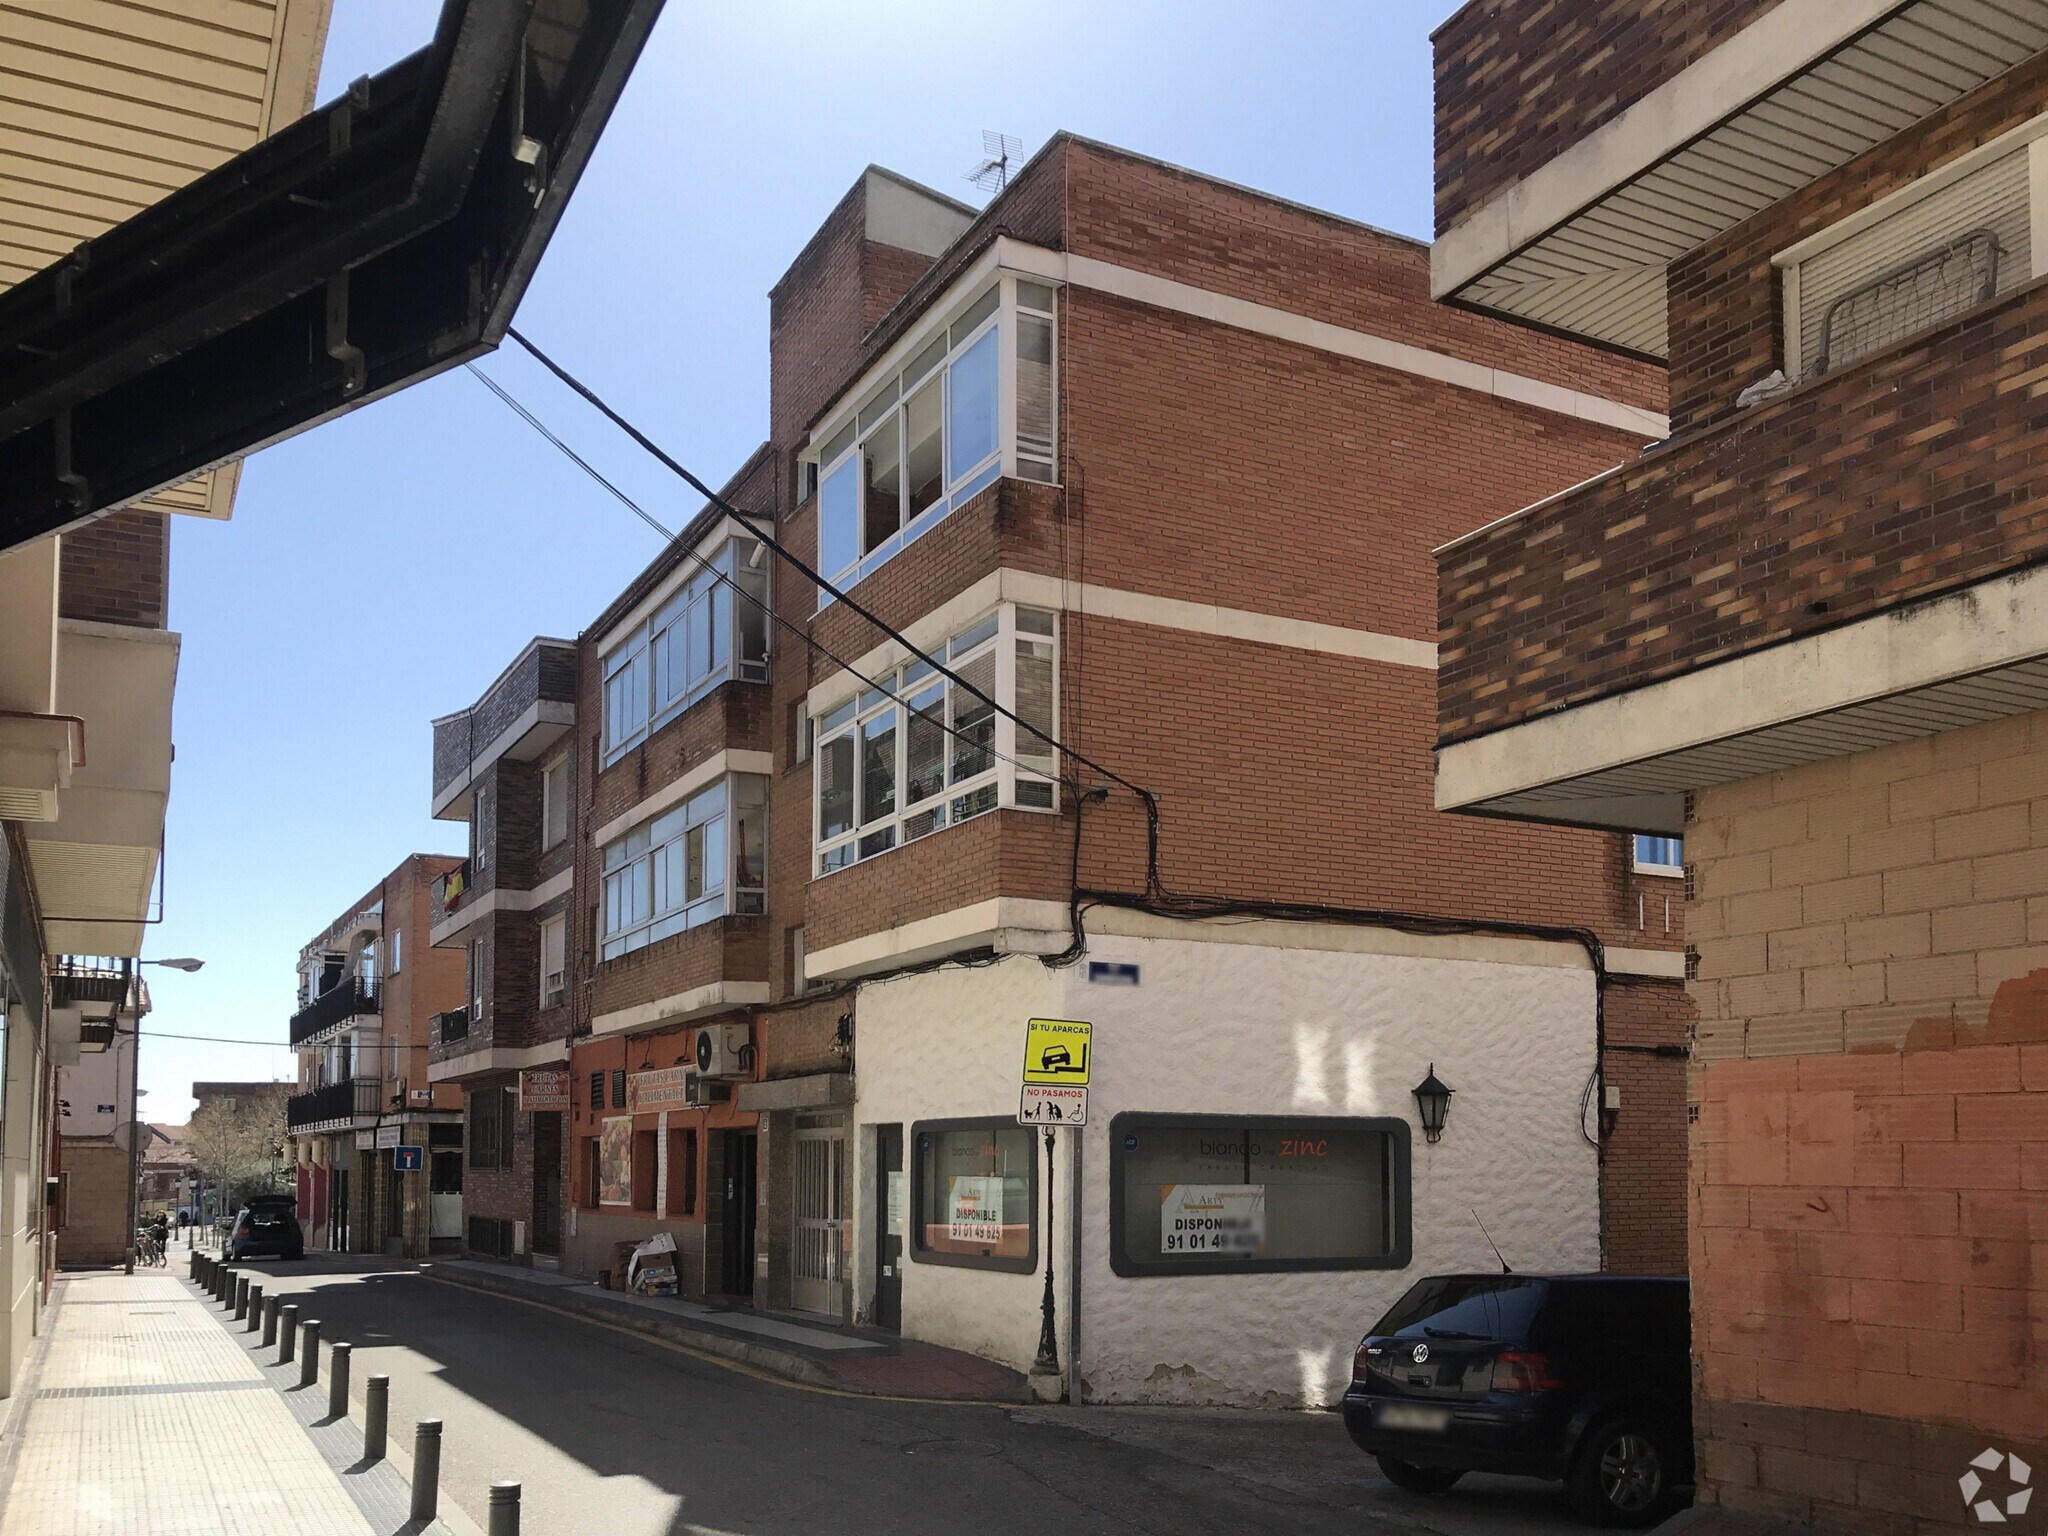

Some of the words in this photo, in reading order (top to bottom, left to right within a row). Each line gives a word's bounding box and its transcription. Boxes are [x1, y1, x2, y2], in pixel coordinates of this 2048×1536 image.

[1030, 1023, 1038, 1031] SI
[1040, 1024, 1050, 1032] TU
[1052, 1025, 1090, 1034] APARCAS
[664, 1068, 686, 1083] CARN
[1026, 1088, 1040, 1096] NO
[1041, 1089, 1083, 1098] PASAMOS
[1279, 1136, 1328, 1157] zinc
[956, 1208, 997, 1221] DISPONIBLE
[952, 1223, 961, 1236] 91
[963, 1224, 973, 1237] 01
[975, 1224, 984, 1239] 49
[1167, 1234, 1183, 1249] 91
[1189, 1234, 1206, 1249] 01
